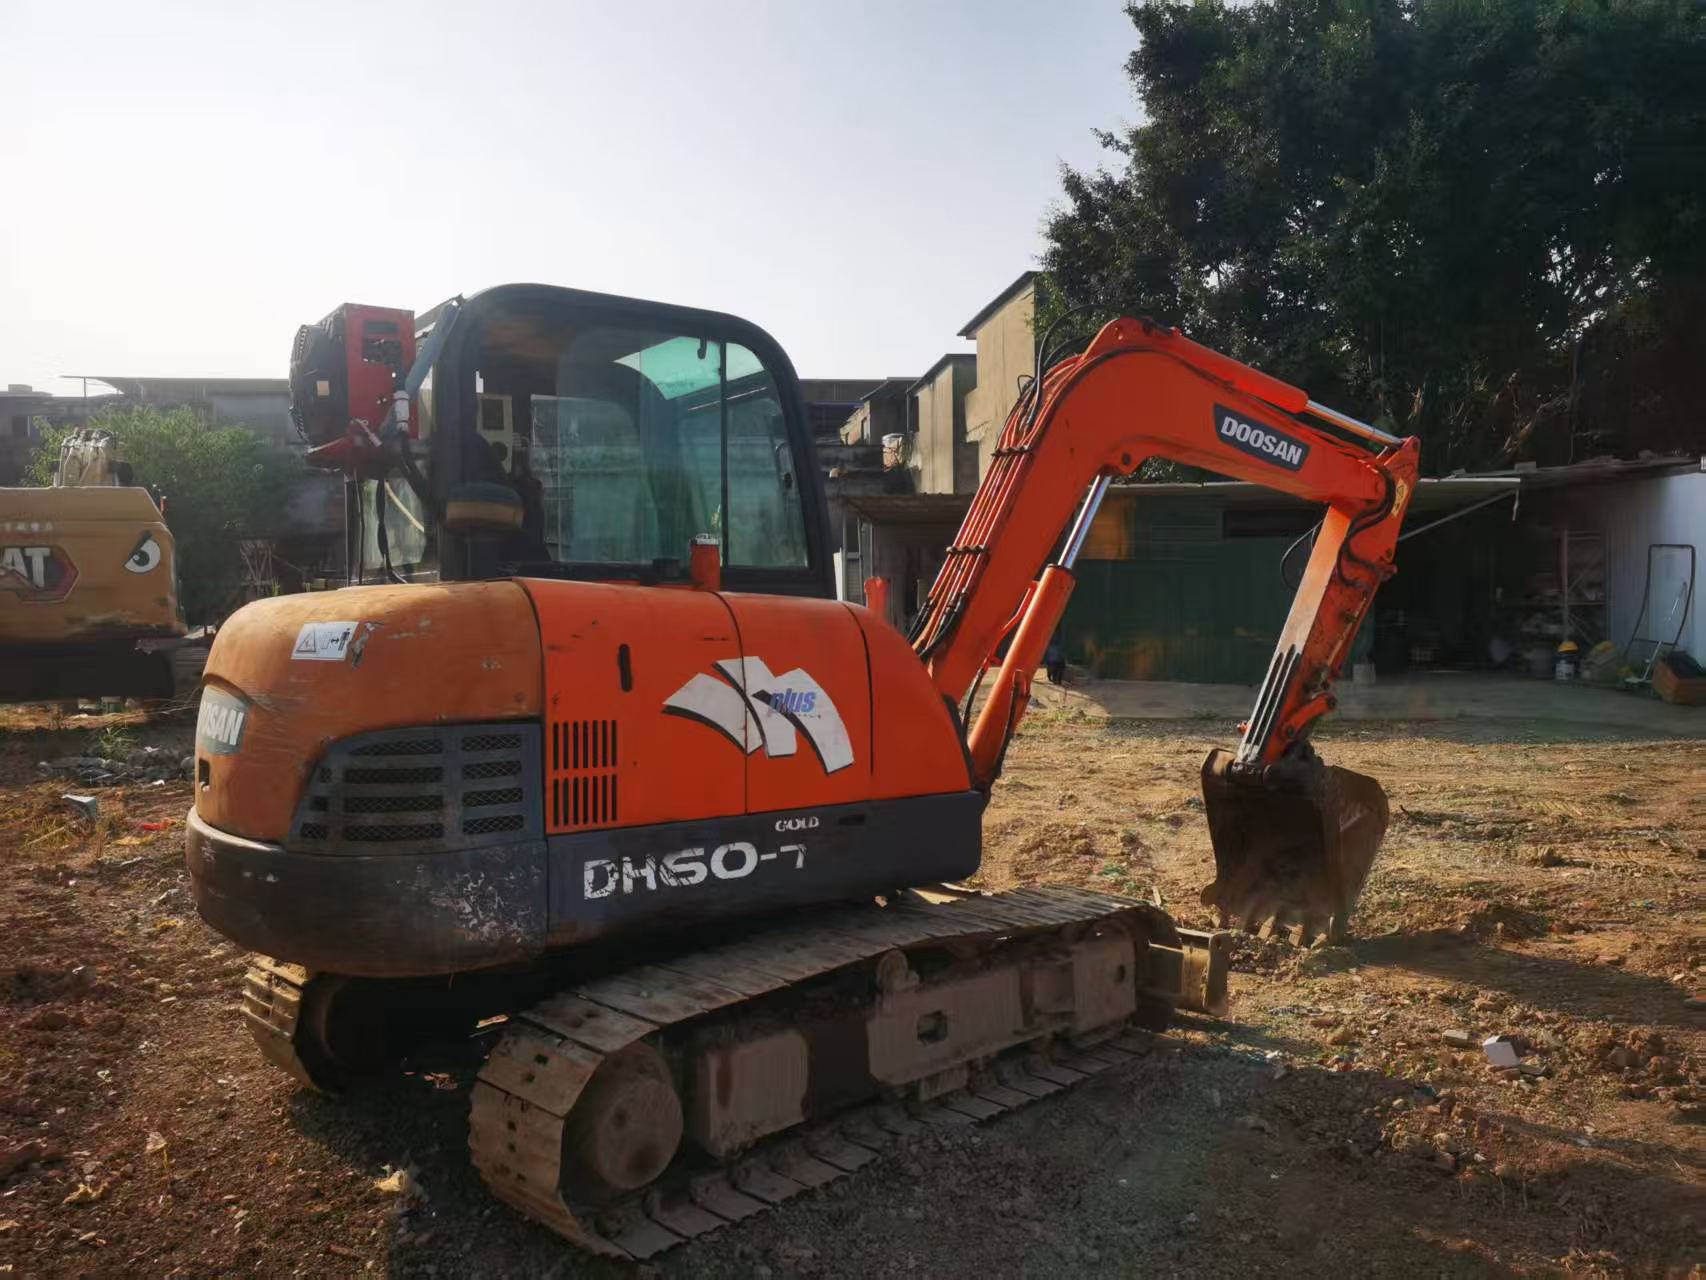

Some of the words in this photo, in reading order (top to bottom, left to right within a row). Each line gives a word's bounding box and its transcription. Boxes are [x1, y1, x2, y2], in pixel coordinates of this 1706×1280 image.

[1221, 416, 1302, 465] DOOSAN
[775, 816, 819, 832] GOLD
[584, 841, 807, 899] DH60-7
